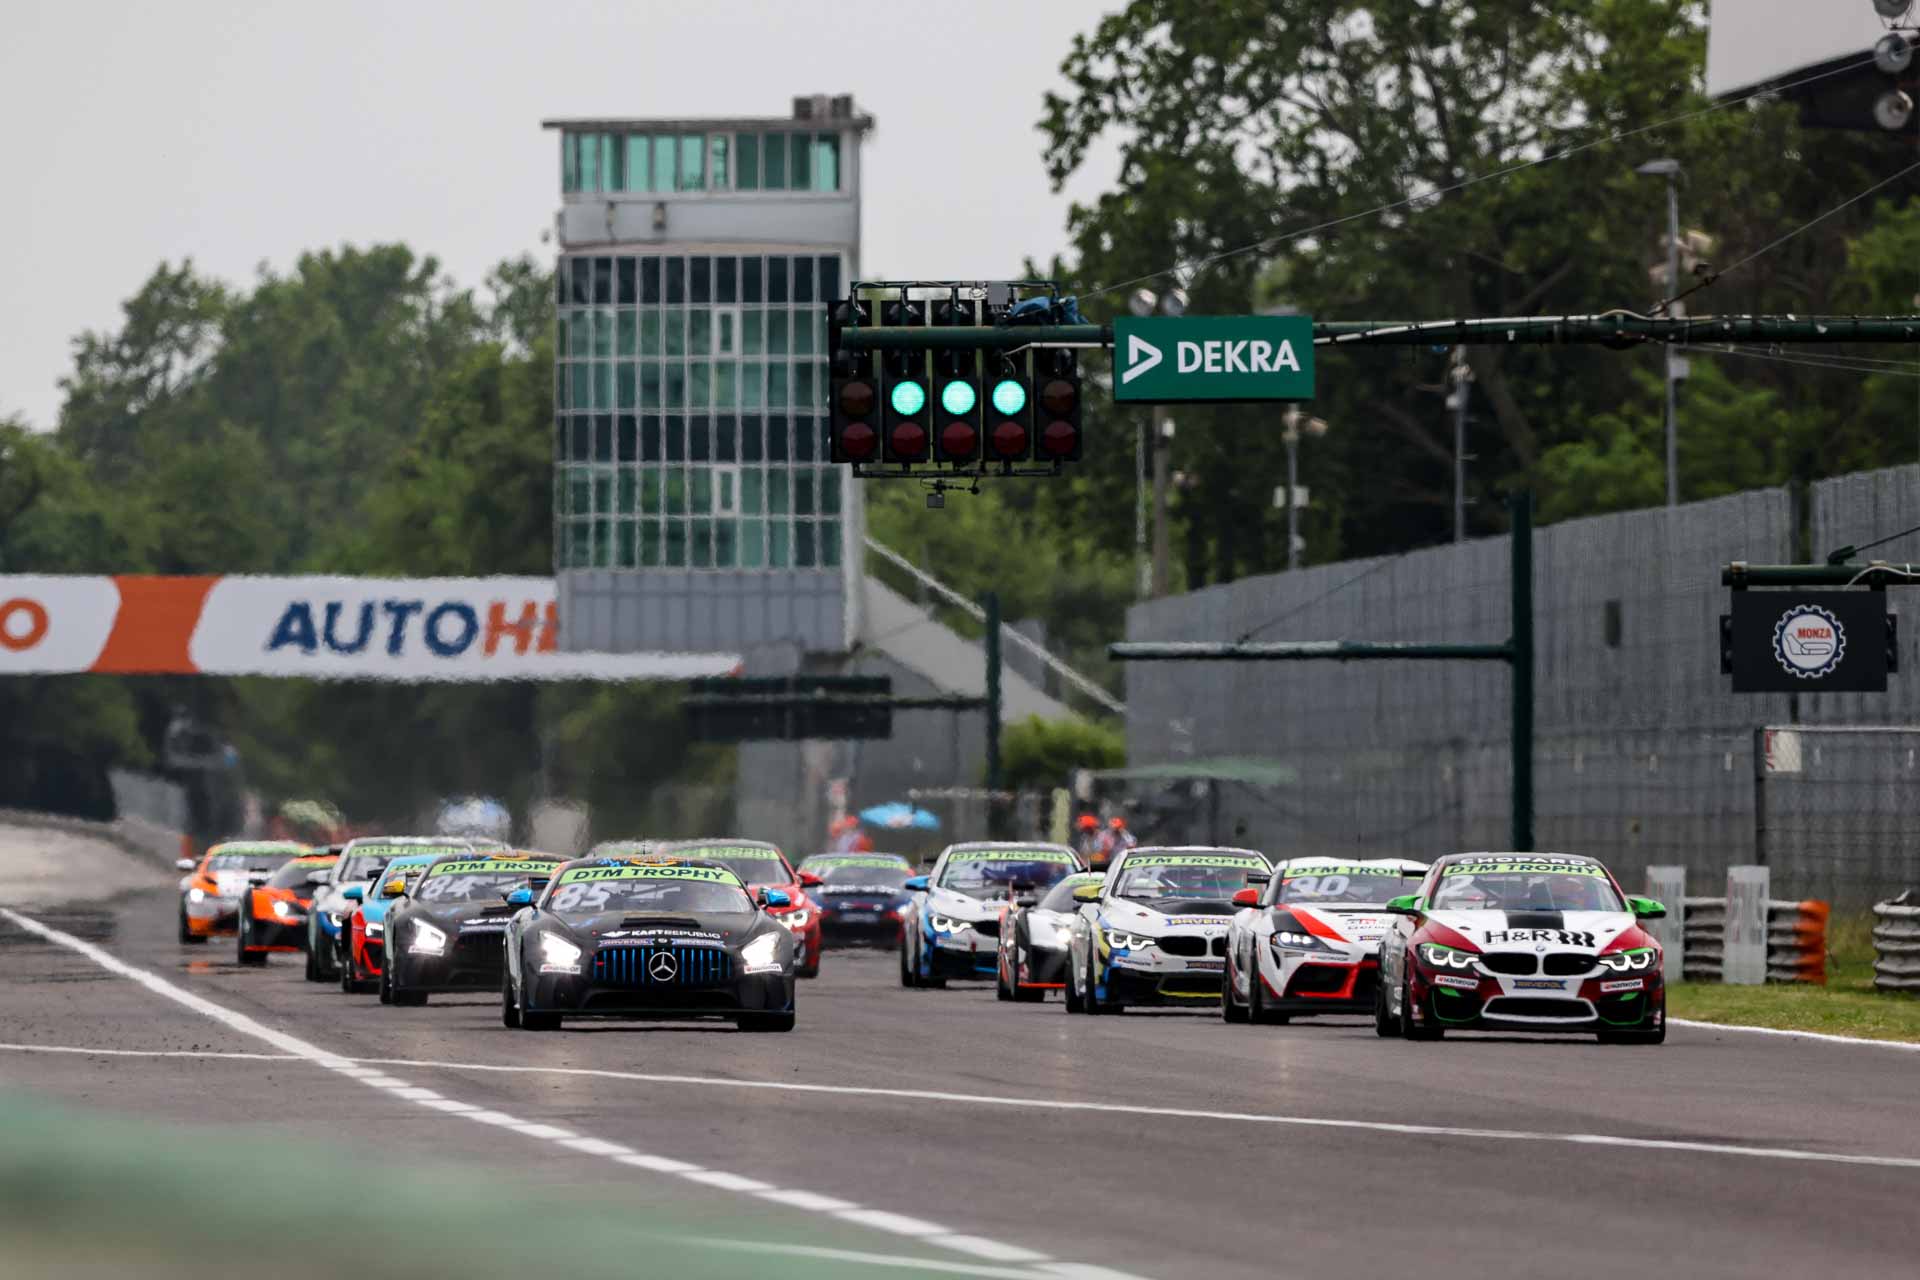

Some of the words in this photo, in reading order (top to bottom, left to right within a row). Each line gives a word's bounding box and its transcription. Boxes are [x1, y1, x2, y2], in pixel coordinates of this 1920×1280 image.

[1177, 339, 1301, 373] DEKRA
[1797, 627, 1832, 640] MONZA
[442, 862, 487, 873] DTM
[1129, 856, 1171, 866] DTM
[1180, 856, 1261, 867] TROPHY
[1460, 856, 1587, 866] CHOPARD
[573, 867, 624, 880] DTM
[631, 866, 725, 880] TROPHY
[1292, 866, 1338, 875] DTM
[1448, 864, 1498, 874] DTM
[1507, 864, 1597, 875] TROPHY
[1289, 876, 1350, 896] 90
[551, 882, 617, 911] 85
[1485, 929, 1552, 944] H&R
